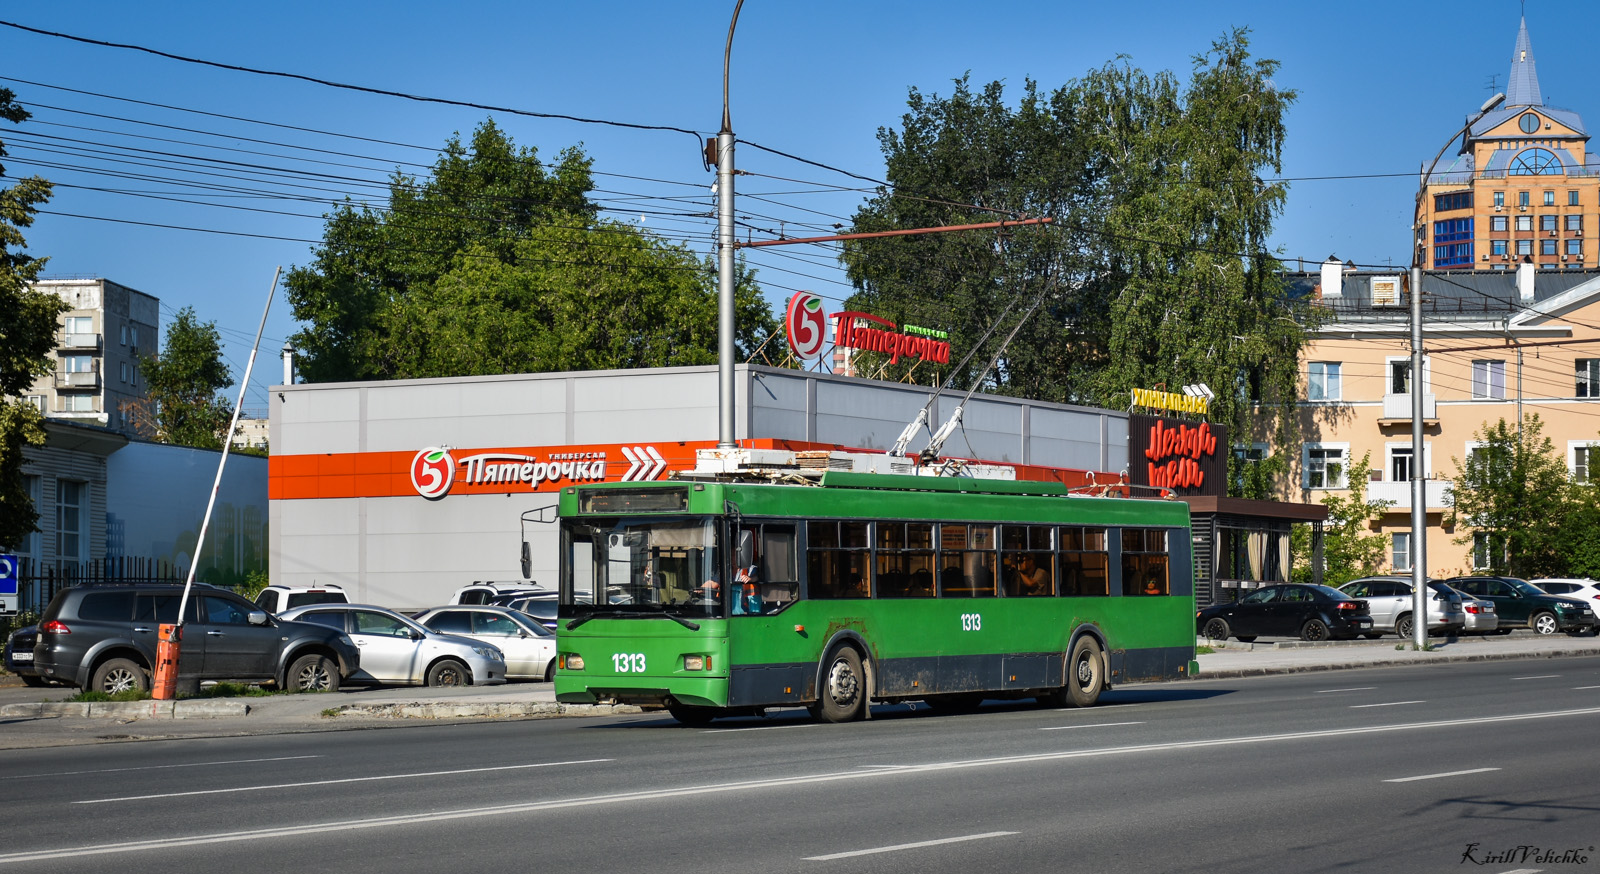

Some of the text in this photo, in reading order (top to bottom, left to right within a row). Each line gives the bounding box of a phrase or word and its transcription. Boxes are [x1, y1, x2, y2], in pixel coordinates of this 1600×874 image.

[1133, 388, 1207, 414] ХИНКАЛЬНАЯ
[548, 452, 606, 460] УНИВЕРСАМ
[419, 451, 606, 496] 5 Пятёрочка
[960, 613, 981, 631] 1313
[612, 653, 646, 673] 1313
